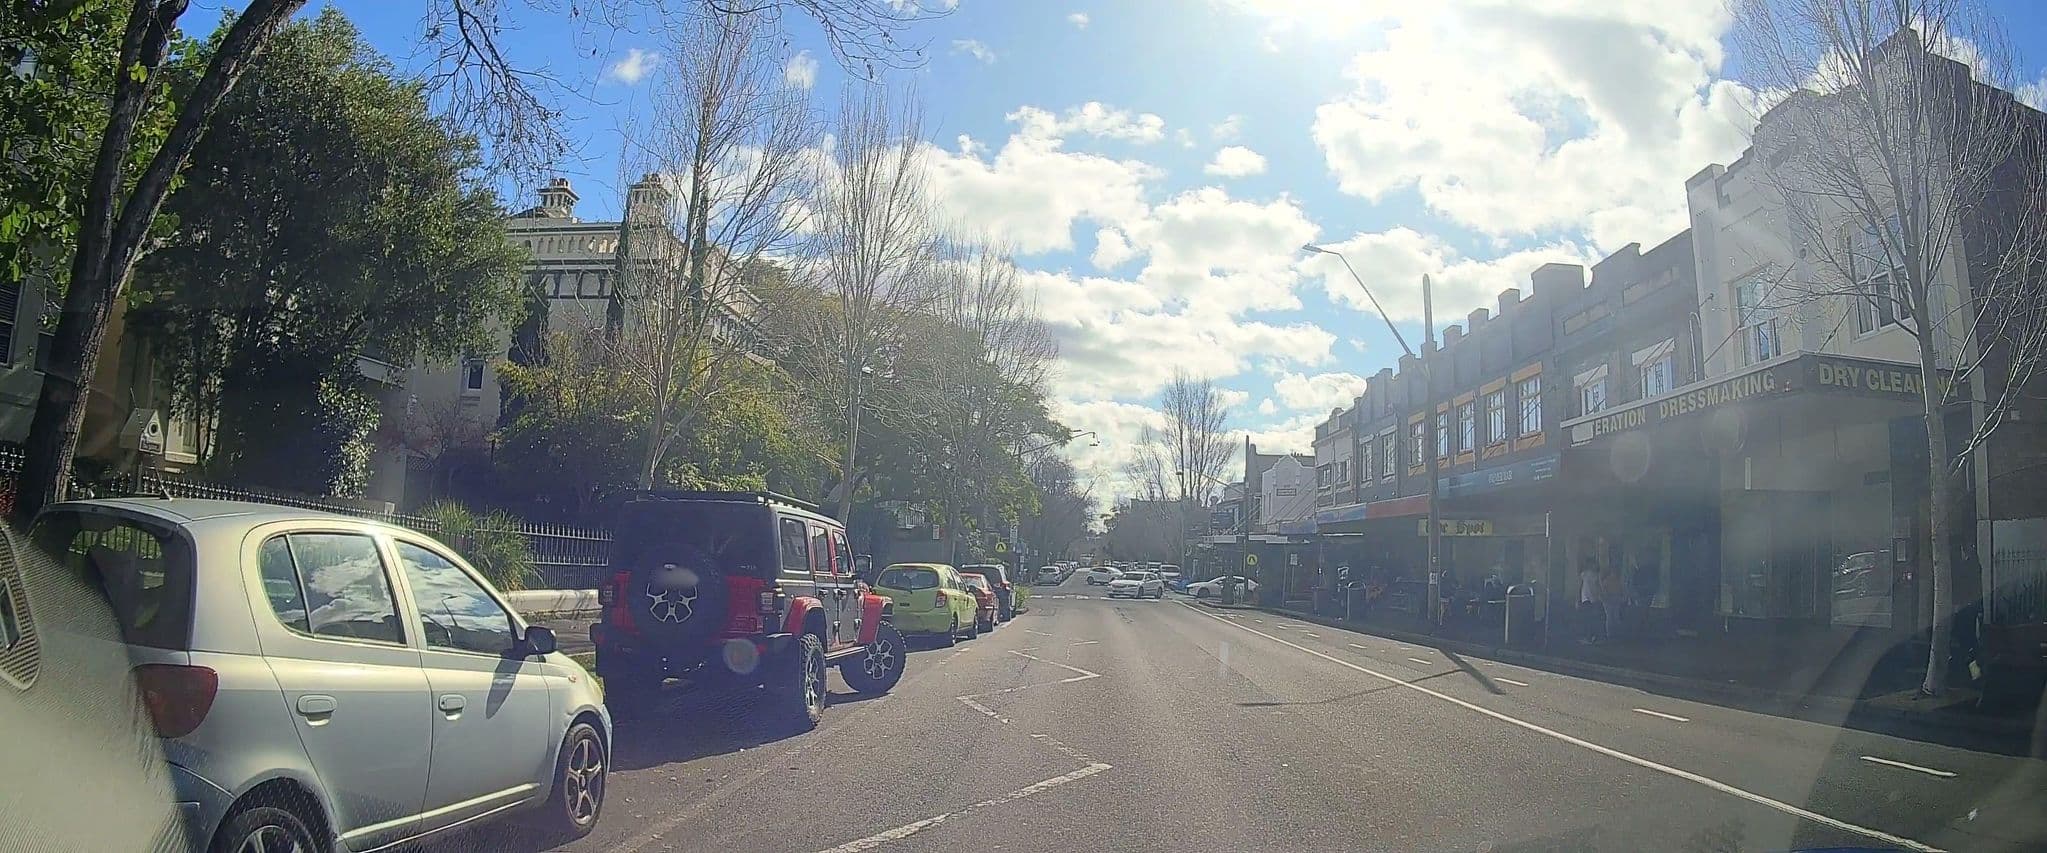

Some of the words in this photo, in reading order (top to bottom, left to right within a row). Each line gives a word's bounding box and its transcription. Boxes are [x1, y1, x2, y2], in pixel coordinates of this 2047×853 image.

[1592, 408, 1647, 436] ERATION
[1659, 371, 1775, 418] DRESSMAKING
[1818, 363, 1862, 389] DRY
[1865, 367, 1959, 398] CLEANNG
